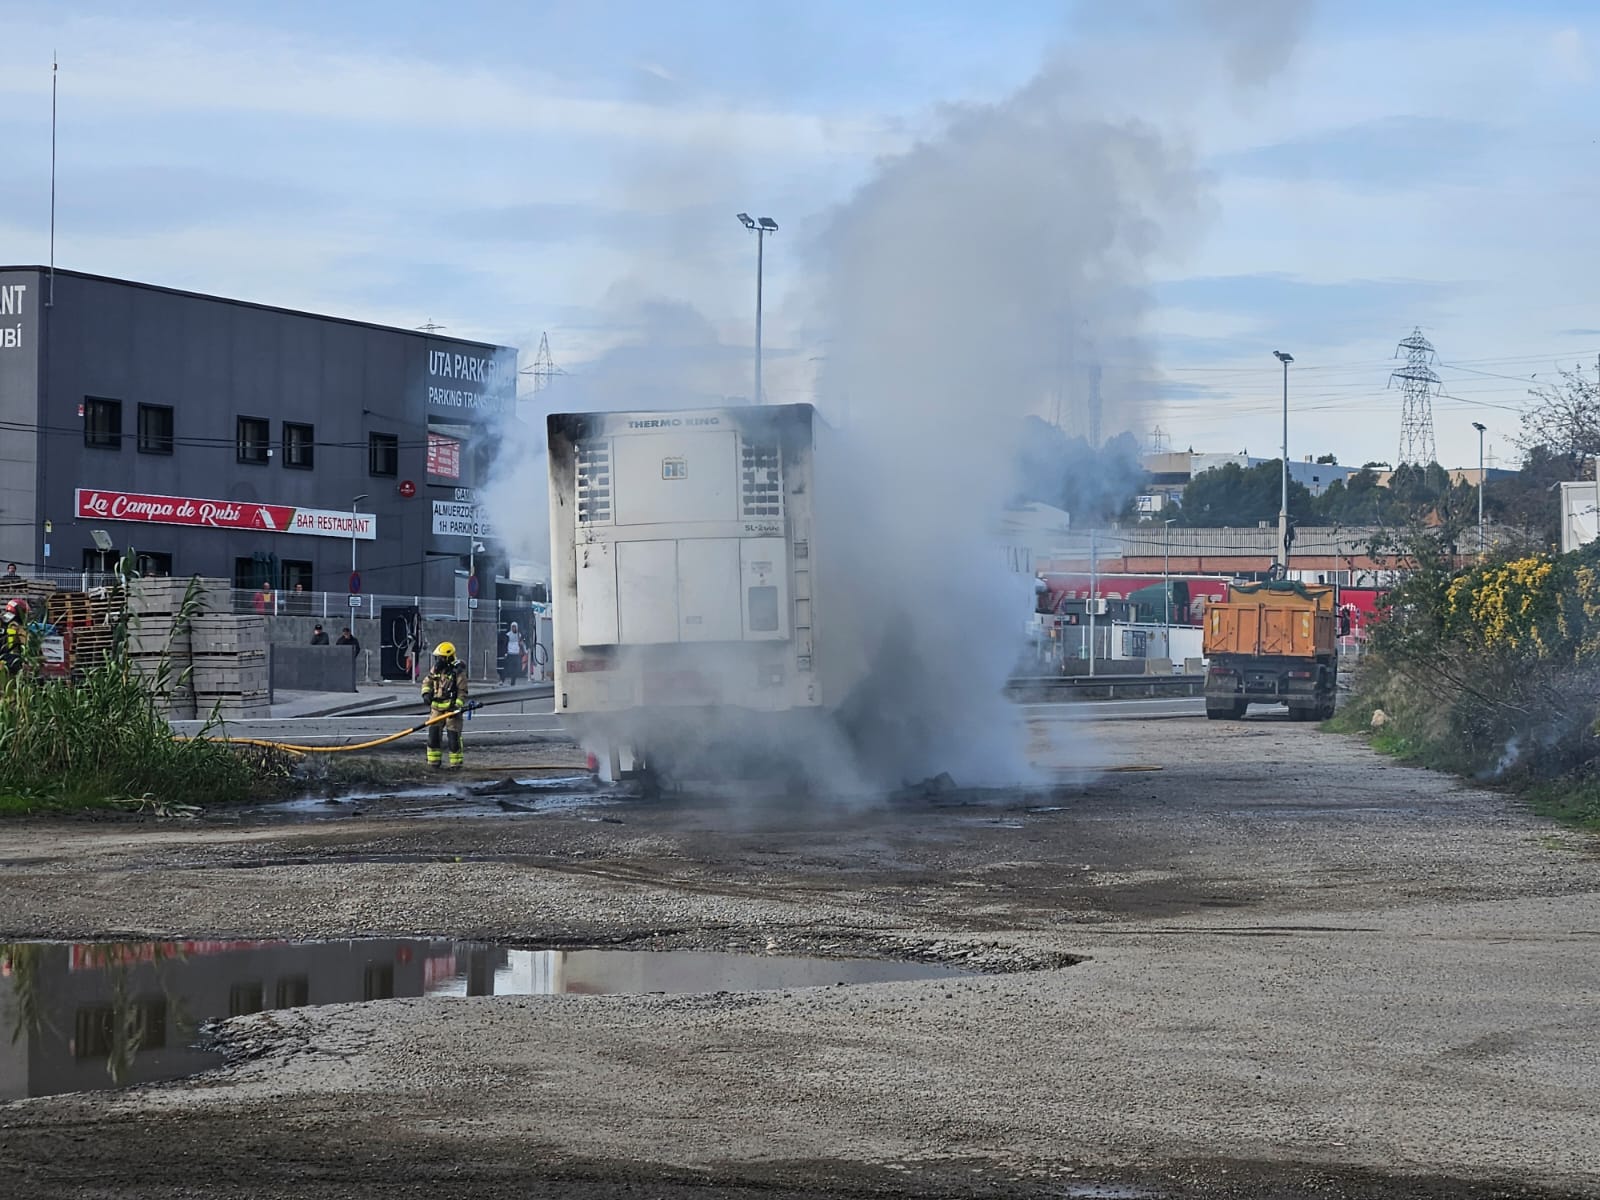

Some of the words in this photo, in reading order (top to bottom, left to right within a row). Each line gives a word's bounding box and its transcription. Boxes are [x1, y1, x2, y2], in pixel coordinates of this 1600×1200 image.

[0, 285, 26, 315] NT
[429, 349, 452, 378] UTA
[454, 354, 486, 383] PARK
[428, 386, 462, 407] PARKING
[628, 418, 681, 429] THERMO
[84, 493, 109, 516] La
[111, 495, 174, 520] Campa
[176, 501, 196, 517] de
[199, 502, 243, 527] Rubí
[296, 514, 314, 529] BAR
[317, 516, 370, 533] RESTAURANT
[449, 520, 479, 535] PARKING
